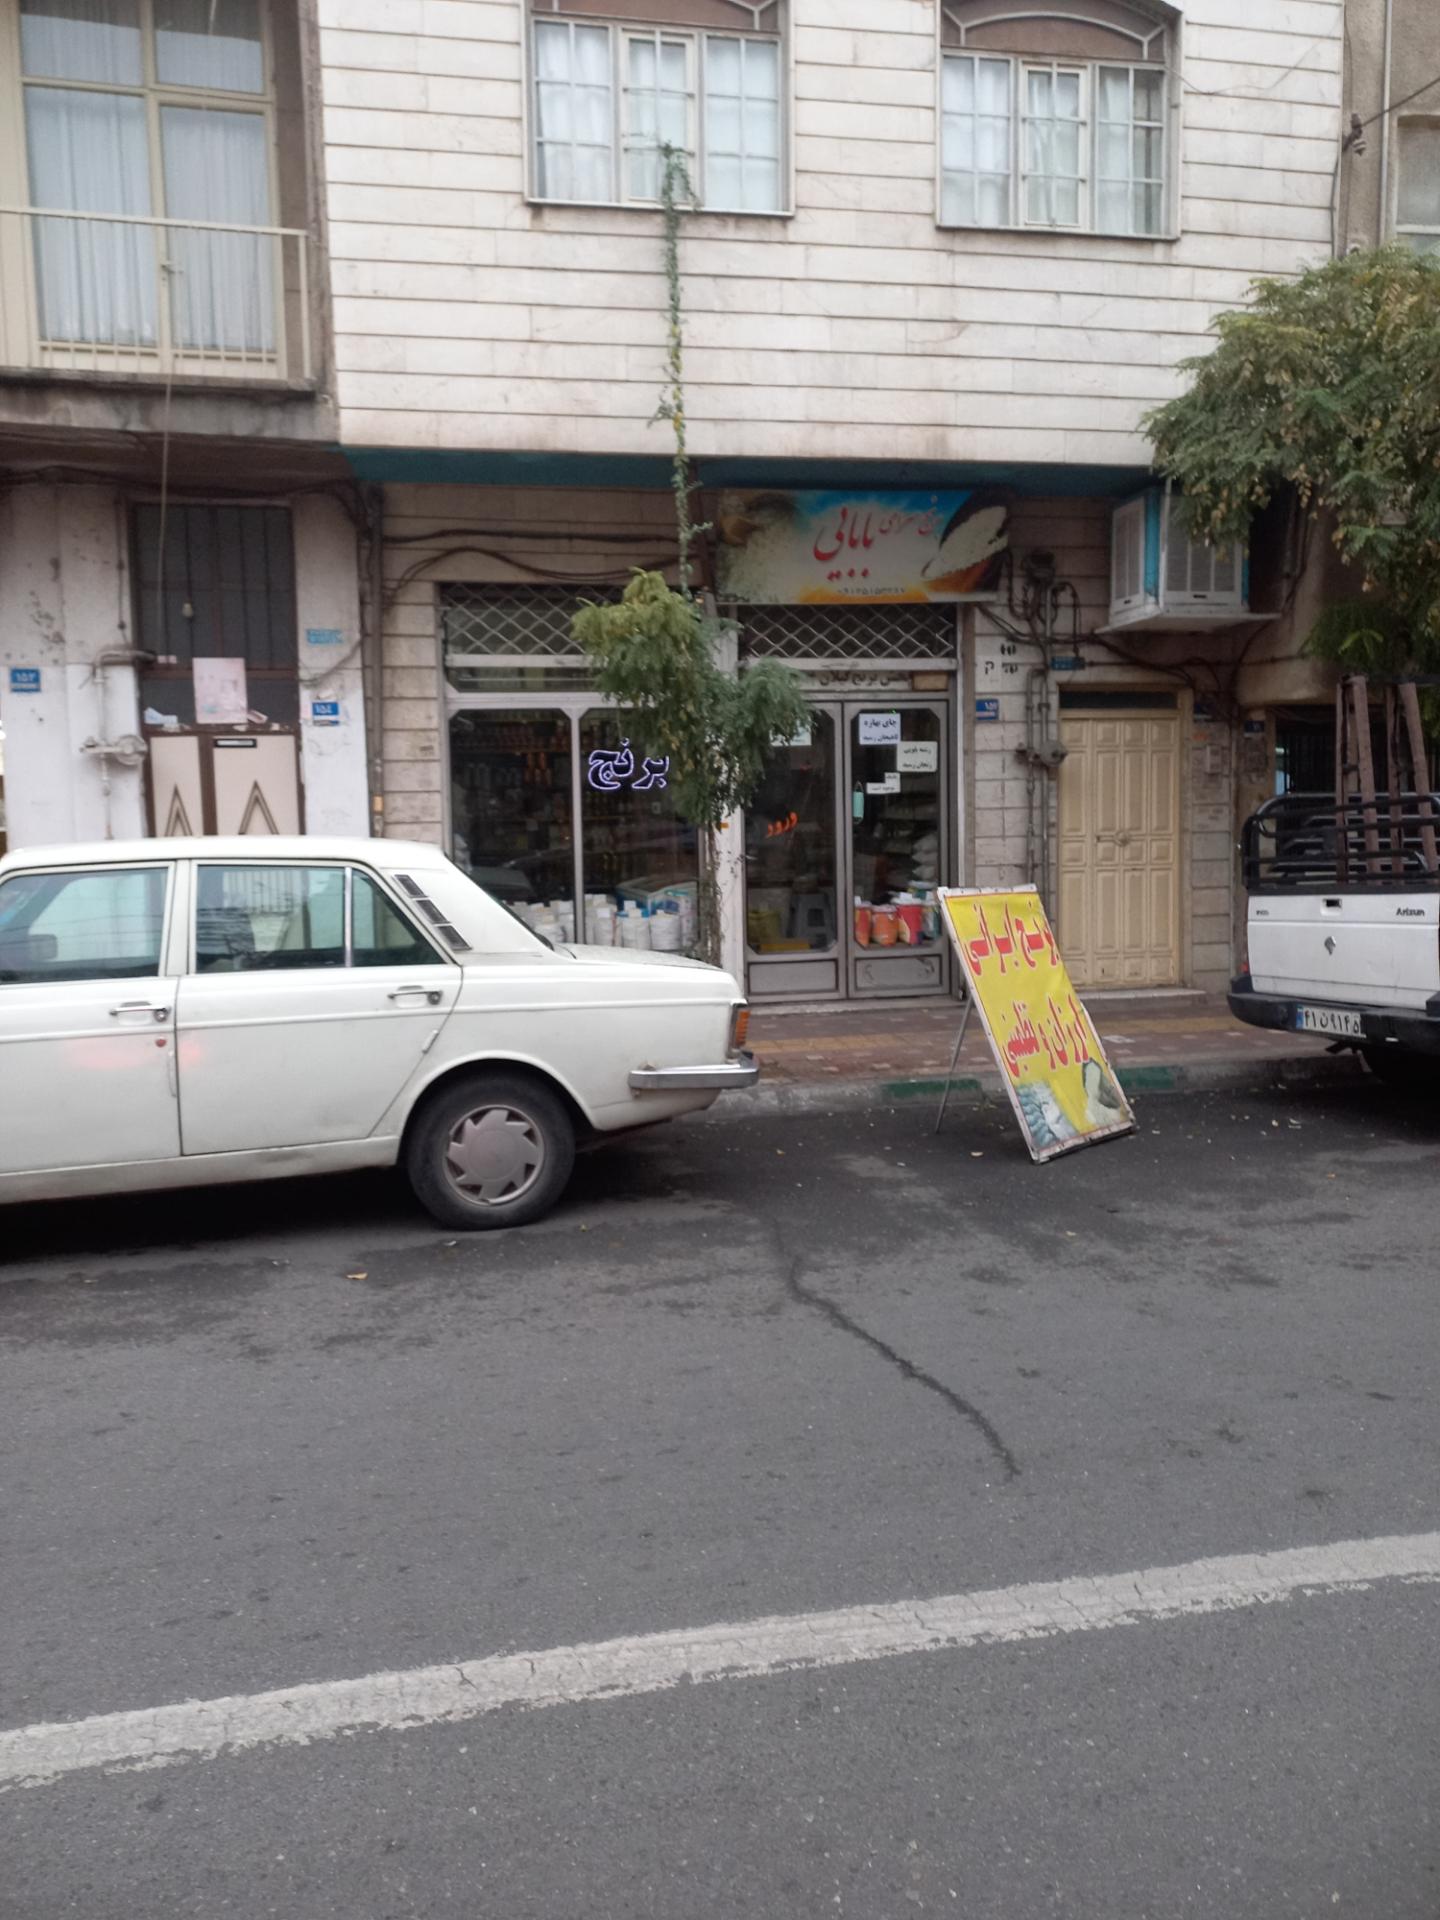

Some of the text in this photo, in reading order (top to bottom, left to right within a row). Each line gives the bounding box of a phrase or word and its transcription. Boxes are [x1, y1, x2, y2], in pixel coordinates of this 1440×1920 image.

[588, 737, 670, 790] برنج
[964, 900, 1061, 976] برنج ایرانی
[1038, 1023, 1056, 1069] و
[1046, 994, 1089, 1066] ارزان
